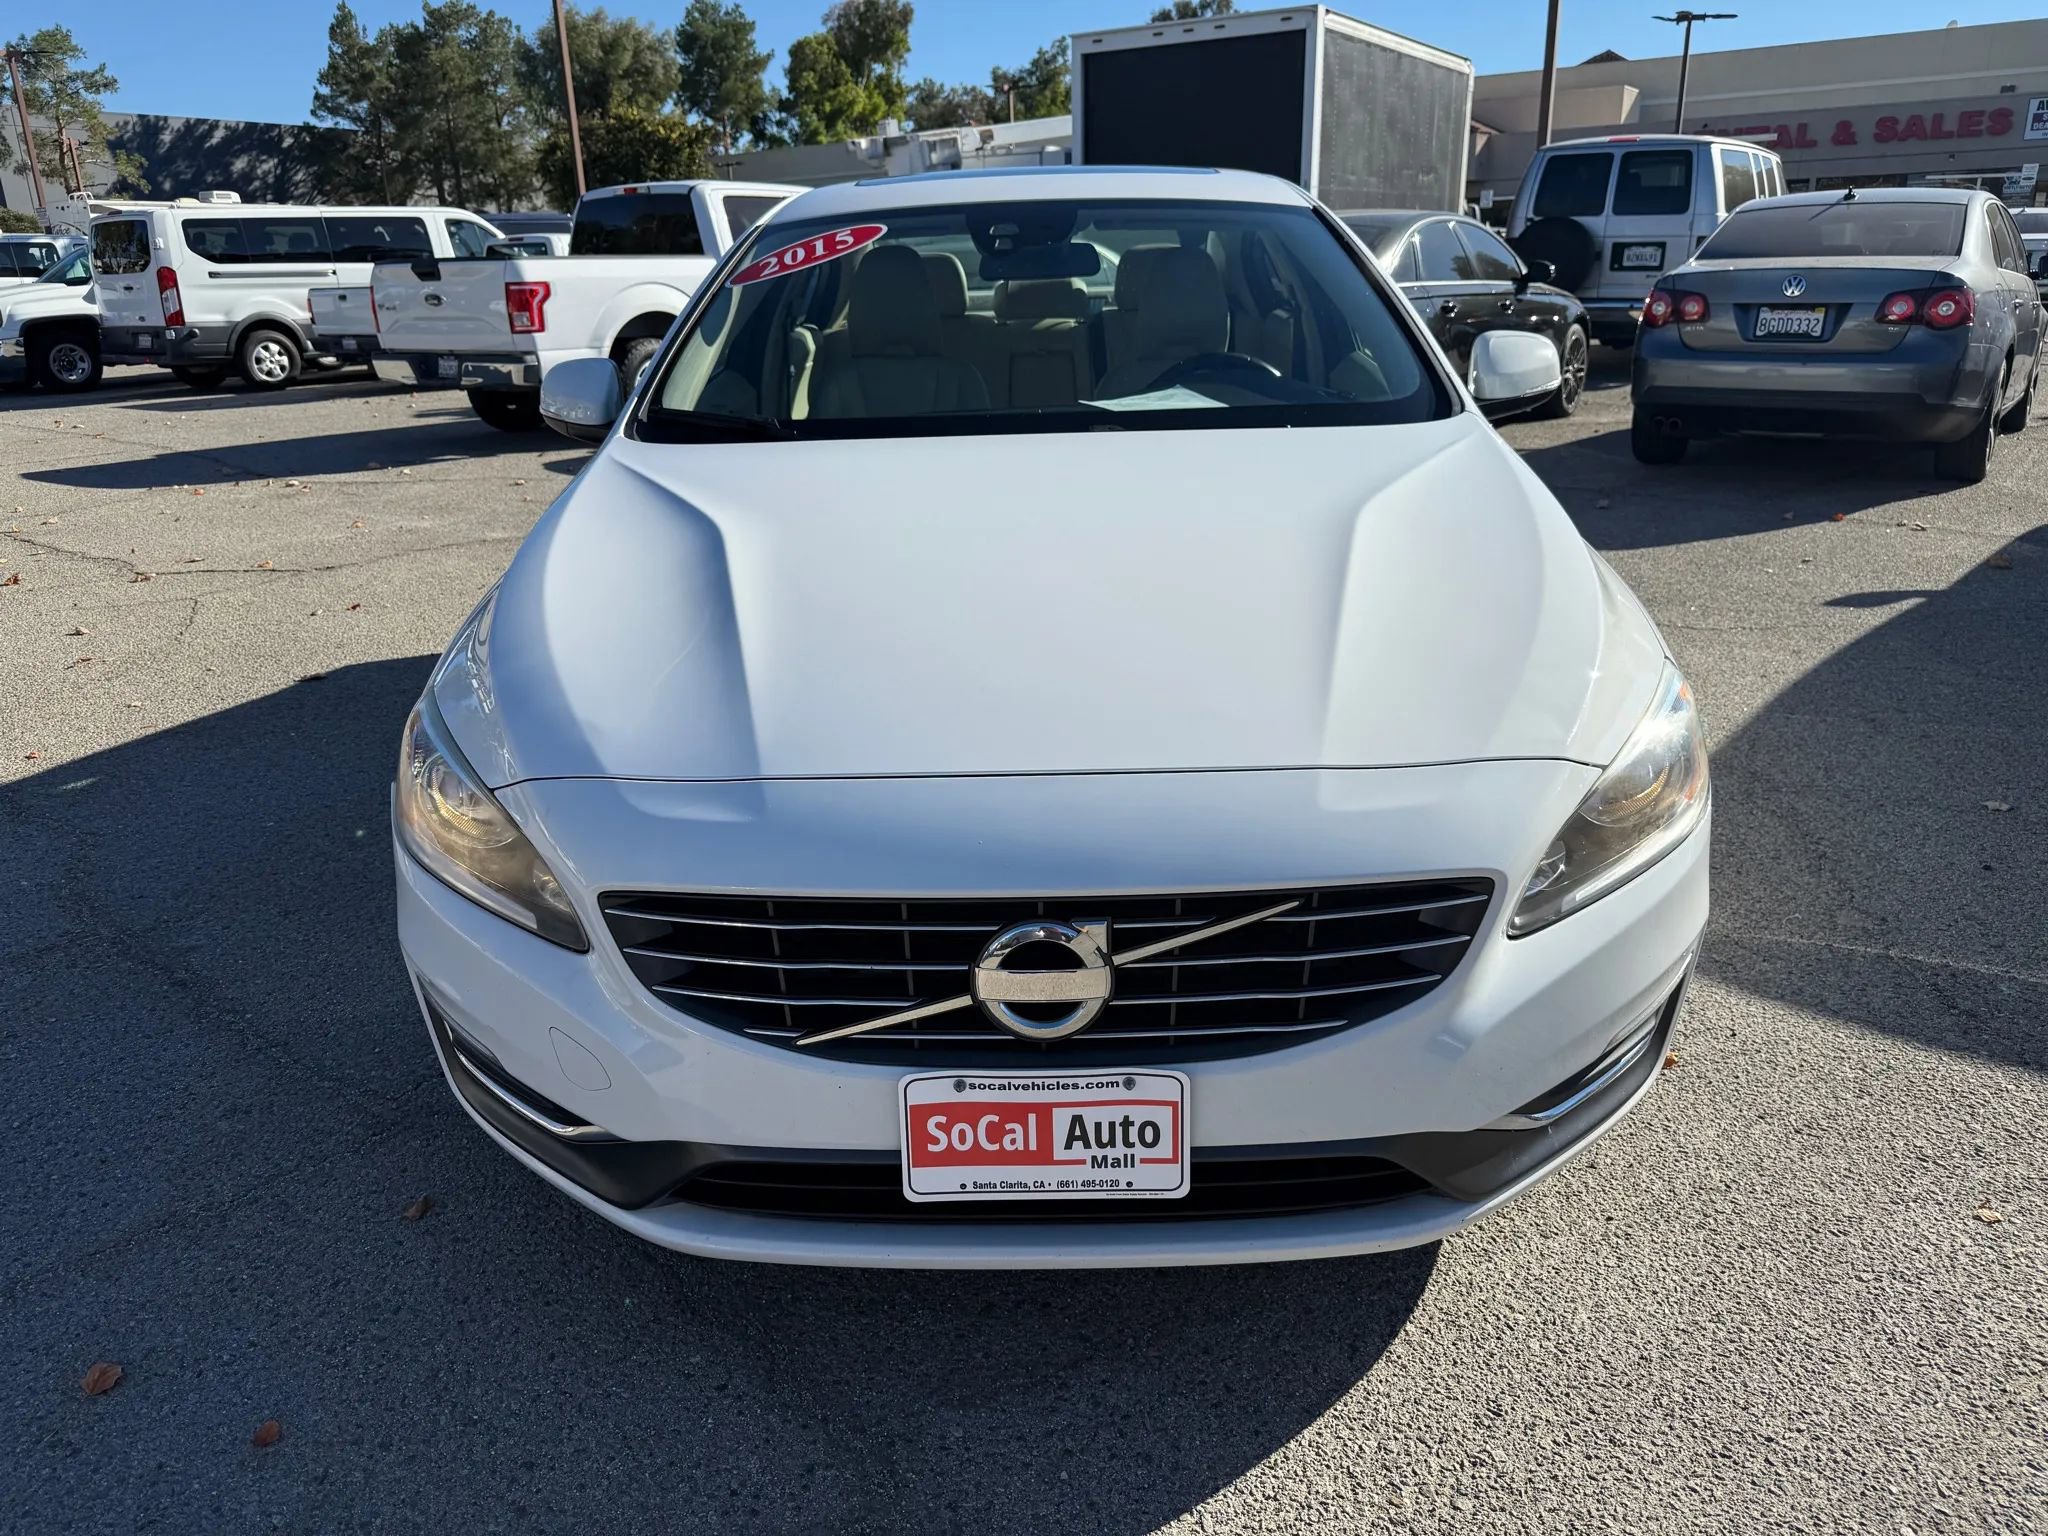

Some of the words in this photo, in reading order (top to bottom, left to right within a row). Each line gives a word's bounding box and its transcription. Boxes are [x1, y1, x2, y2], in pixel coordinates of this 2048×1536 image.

[1831, 120, 1858, 146] &
[1873, 107, 2013, 142] SALES
[759, 230, 854, 277] 2015
[1758, 317, 1820, 334] 8GDD332
[968, 1079, 1120, 1092] socalvehicles.com
[927, 1113, 1037, 1152] SoCal
[1063, 1114, 1161, 1151] Auto
[1091, 1153, 1136, 1169] Mall
[972, 1180, 998, 1190] Santa
[999, 1180, 1031, 1191] Clarita,
[1033, 1180, 1046, 1190] CA
[1056, 1179, 1079, 1190] (661)
[1081, 1179, 1120, 1189] 495-0120
